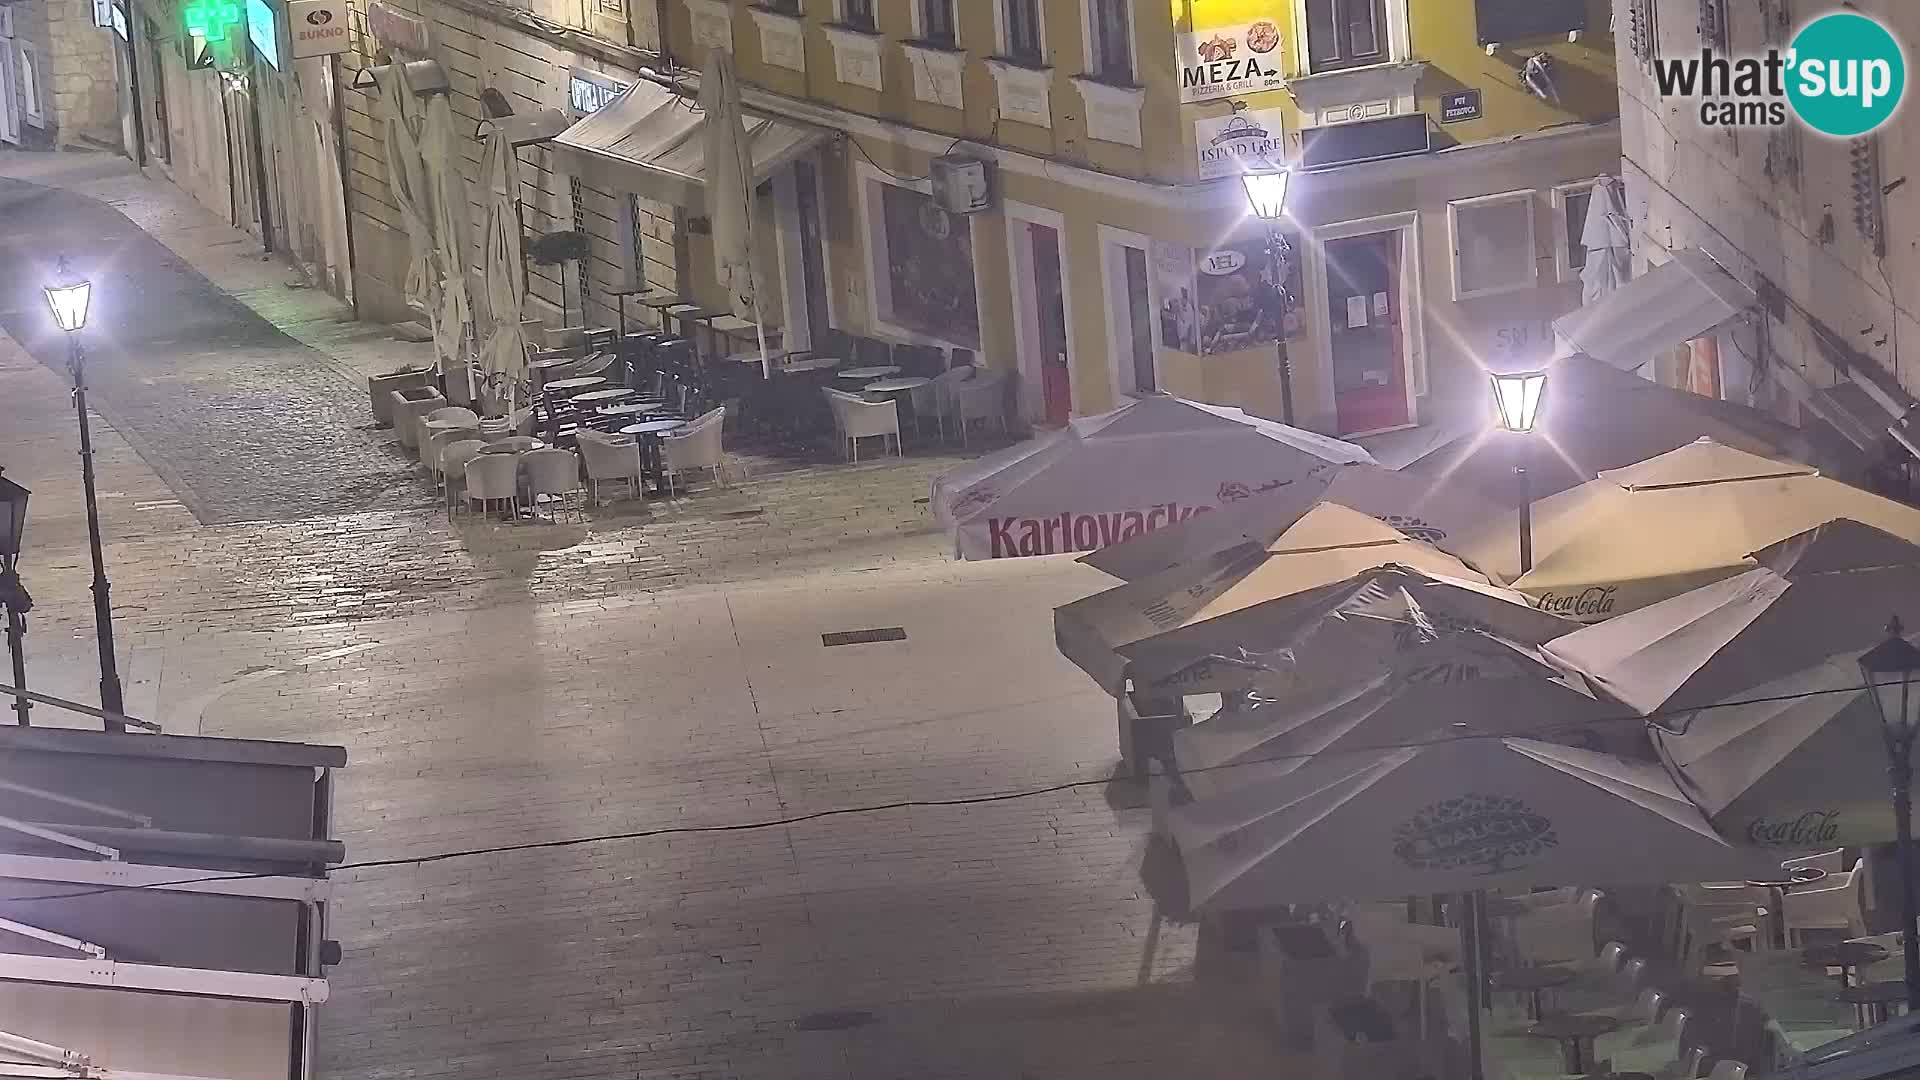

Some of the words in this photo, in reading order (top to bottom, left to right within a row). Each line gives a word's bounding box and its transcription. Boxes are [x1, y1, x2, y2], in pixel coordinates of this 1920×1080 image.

[300, 27, 344, 41] BUKNO
[1183, 58, 1262, 88] MEZA
[1192, 83, 1226, 97] PIZZERIA
[1226, 82, 1232, 91] &
[1232, 81, 1254, 91] GRILL
[1264, 79, 1280, 87] 80m
[1201, 143, 1247, 162] ISPOD
[1534, 584, 1617, 616] Coca-Cola
